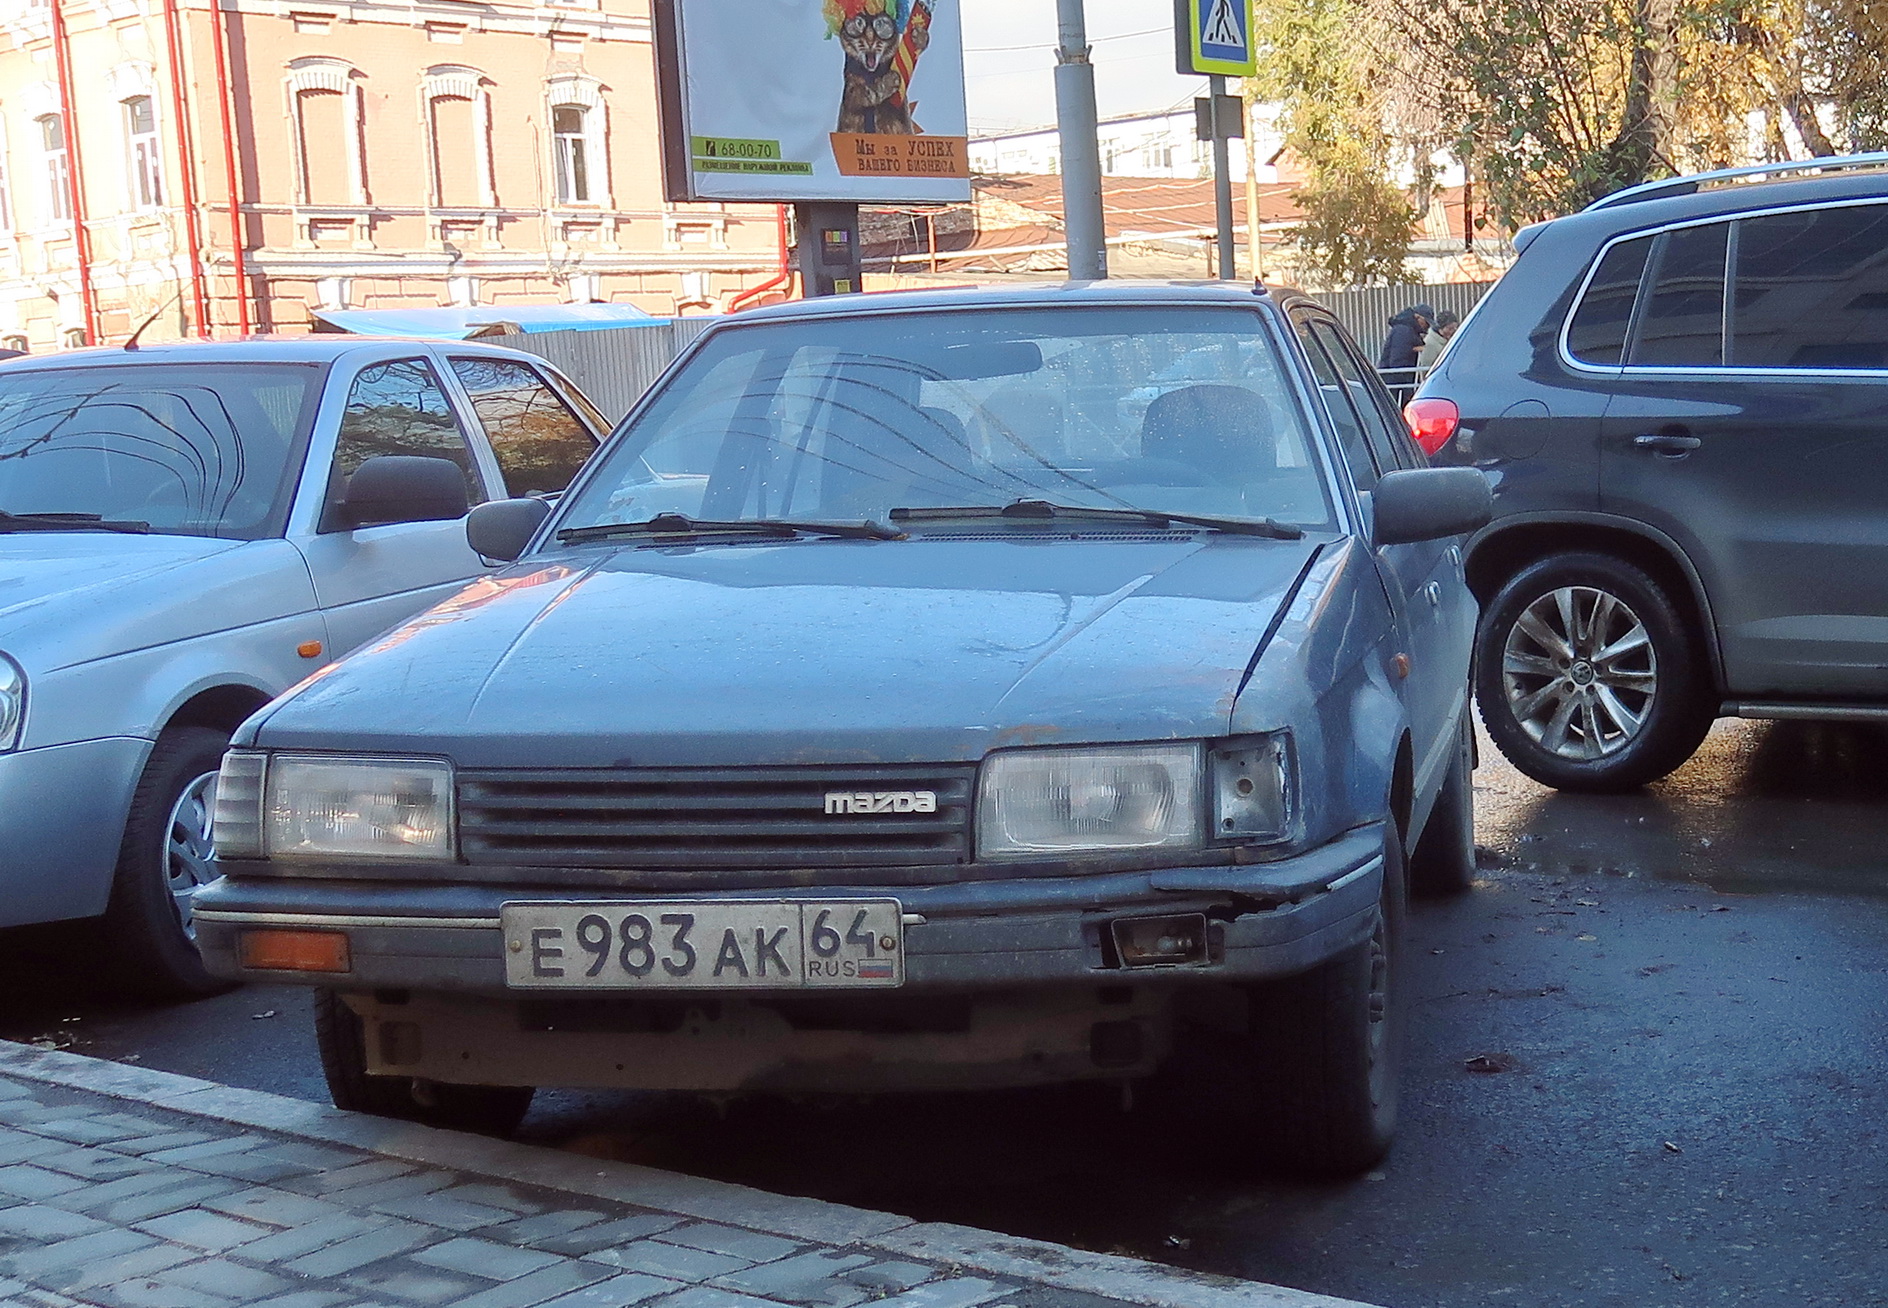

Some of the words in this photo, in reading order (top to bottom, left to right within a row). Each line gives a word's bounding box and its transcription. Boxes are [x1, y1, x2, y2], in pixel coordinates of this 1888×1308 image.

[855, 139, 875, 155] Мы
[884, 145, 898, 155] за
[908, 140, 954, 157] УСПЕХ
[857, 158, 901, 172] ВАШЕГО
[906, 159, 956, 173] БИЗНЕСА
[824, 790, 937, 814] mazda
[811, 908, 876, 958] 64
[808, 960, 856, 978] RUS
